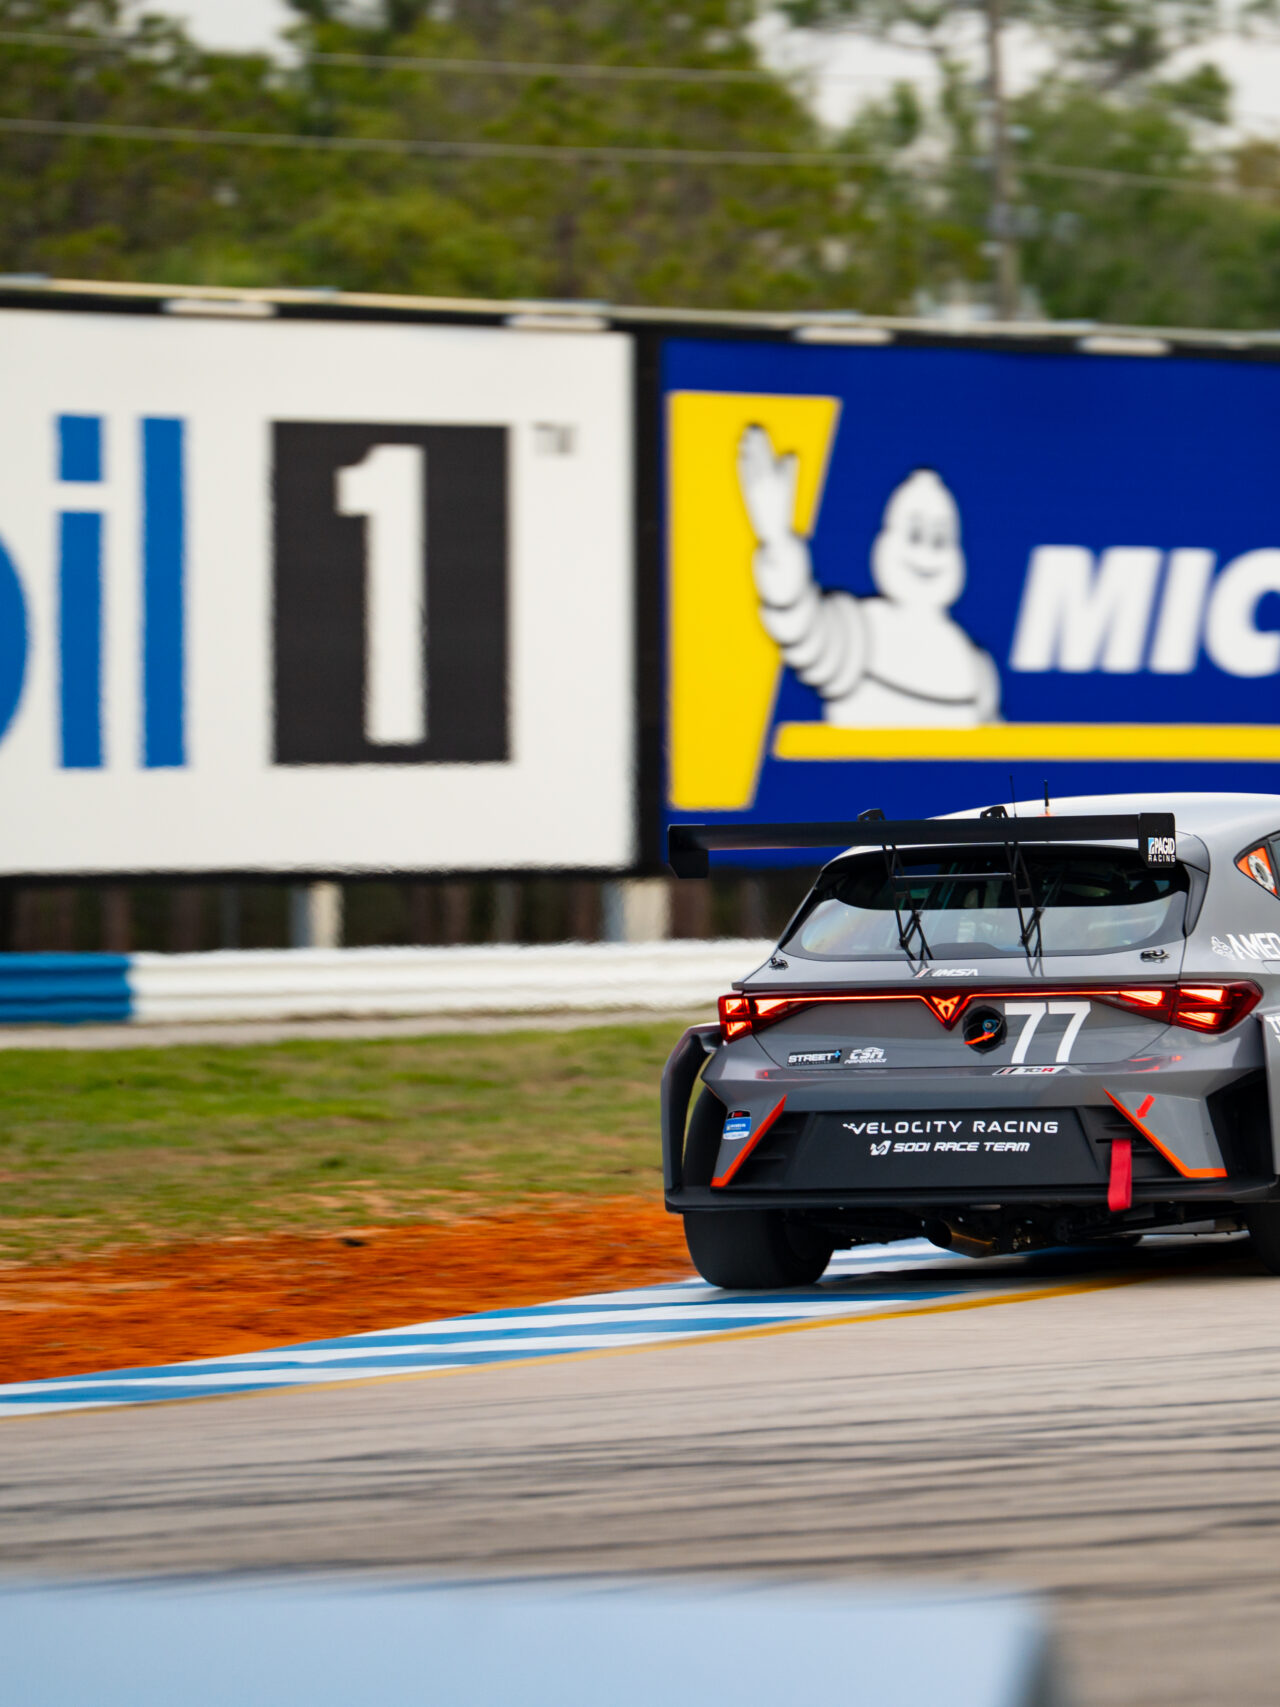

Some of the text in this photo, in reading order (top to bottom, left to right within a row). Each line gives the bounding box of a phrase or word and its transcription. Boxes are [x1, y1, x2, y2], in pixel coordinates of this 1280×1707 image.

[0, 413, 188, 768] il
[334, 443, 427, 746] 1
[1153, 836, 1176, 855] PAGID
[1147, 854, 1176, 863] RACING
[931, 968, 979, 977] IMSA
[1004, 1001, 1092, 1064] 77
[843, 1120, 1059, 1135] VELOCITY RACING
[892, 1141, 1031, 1153] SODI RACE TEAM
